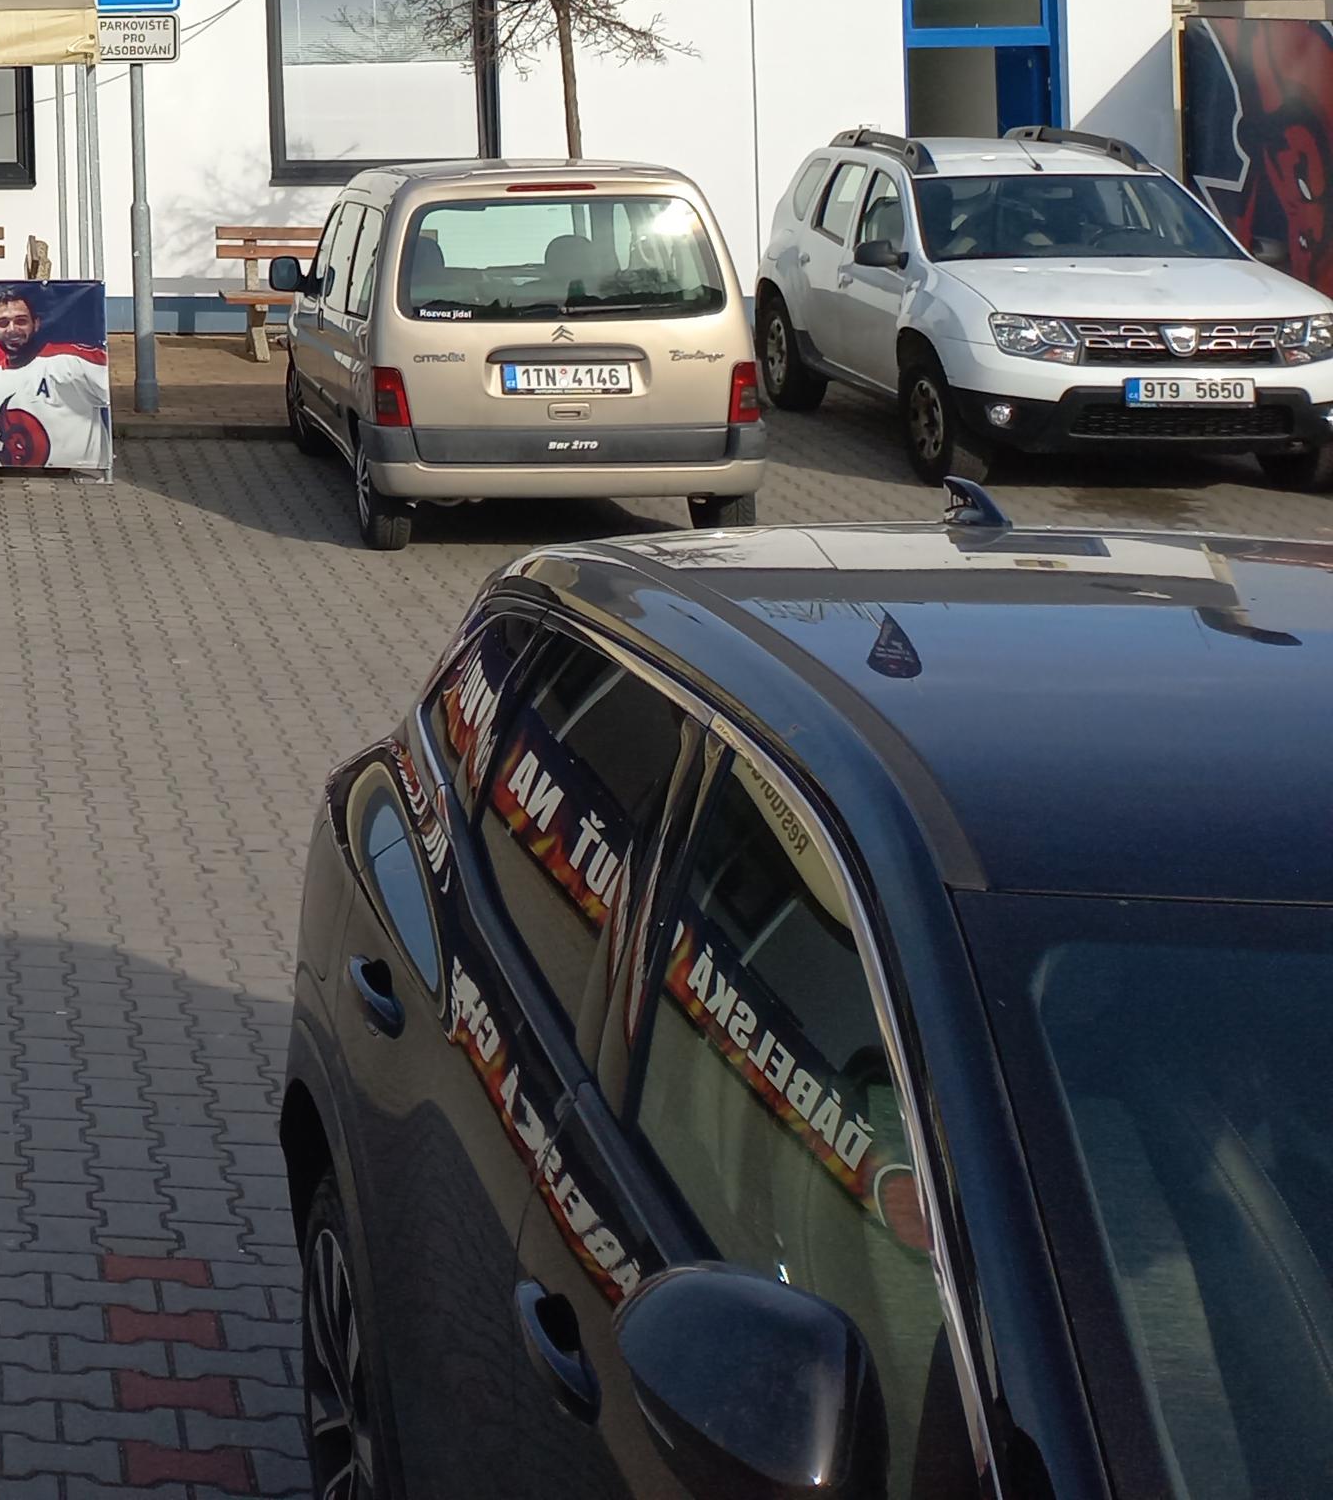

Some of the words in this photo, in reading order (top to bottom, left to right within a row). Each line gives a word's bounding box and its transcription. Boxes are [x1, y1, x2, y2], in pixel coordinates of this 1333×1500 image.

[100, 19, 170, 31] PARKOVIŠTĚ
[122, 33, 146, 43] PRO
[100, 44, 171, 56] ZÁSOBOVÁNÍ
[419, 309, 452, 318] Rozvoz
[521, 367, 557, 387] 1TN
[572, 367, 620, 387] 4146
[36, 377, 51, 398] A
[505, 380, 516, 388] CZ
[1143, 381, 1181, 399] 9T9
[1195, 381, 1245, 399] 5650
[547, 441, 570, 450] Bar
